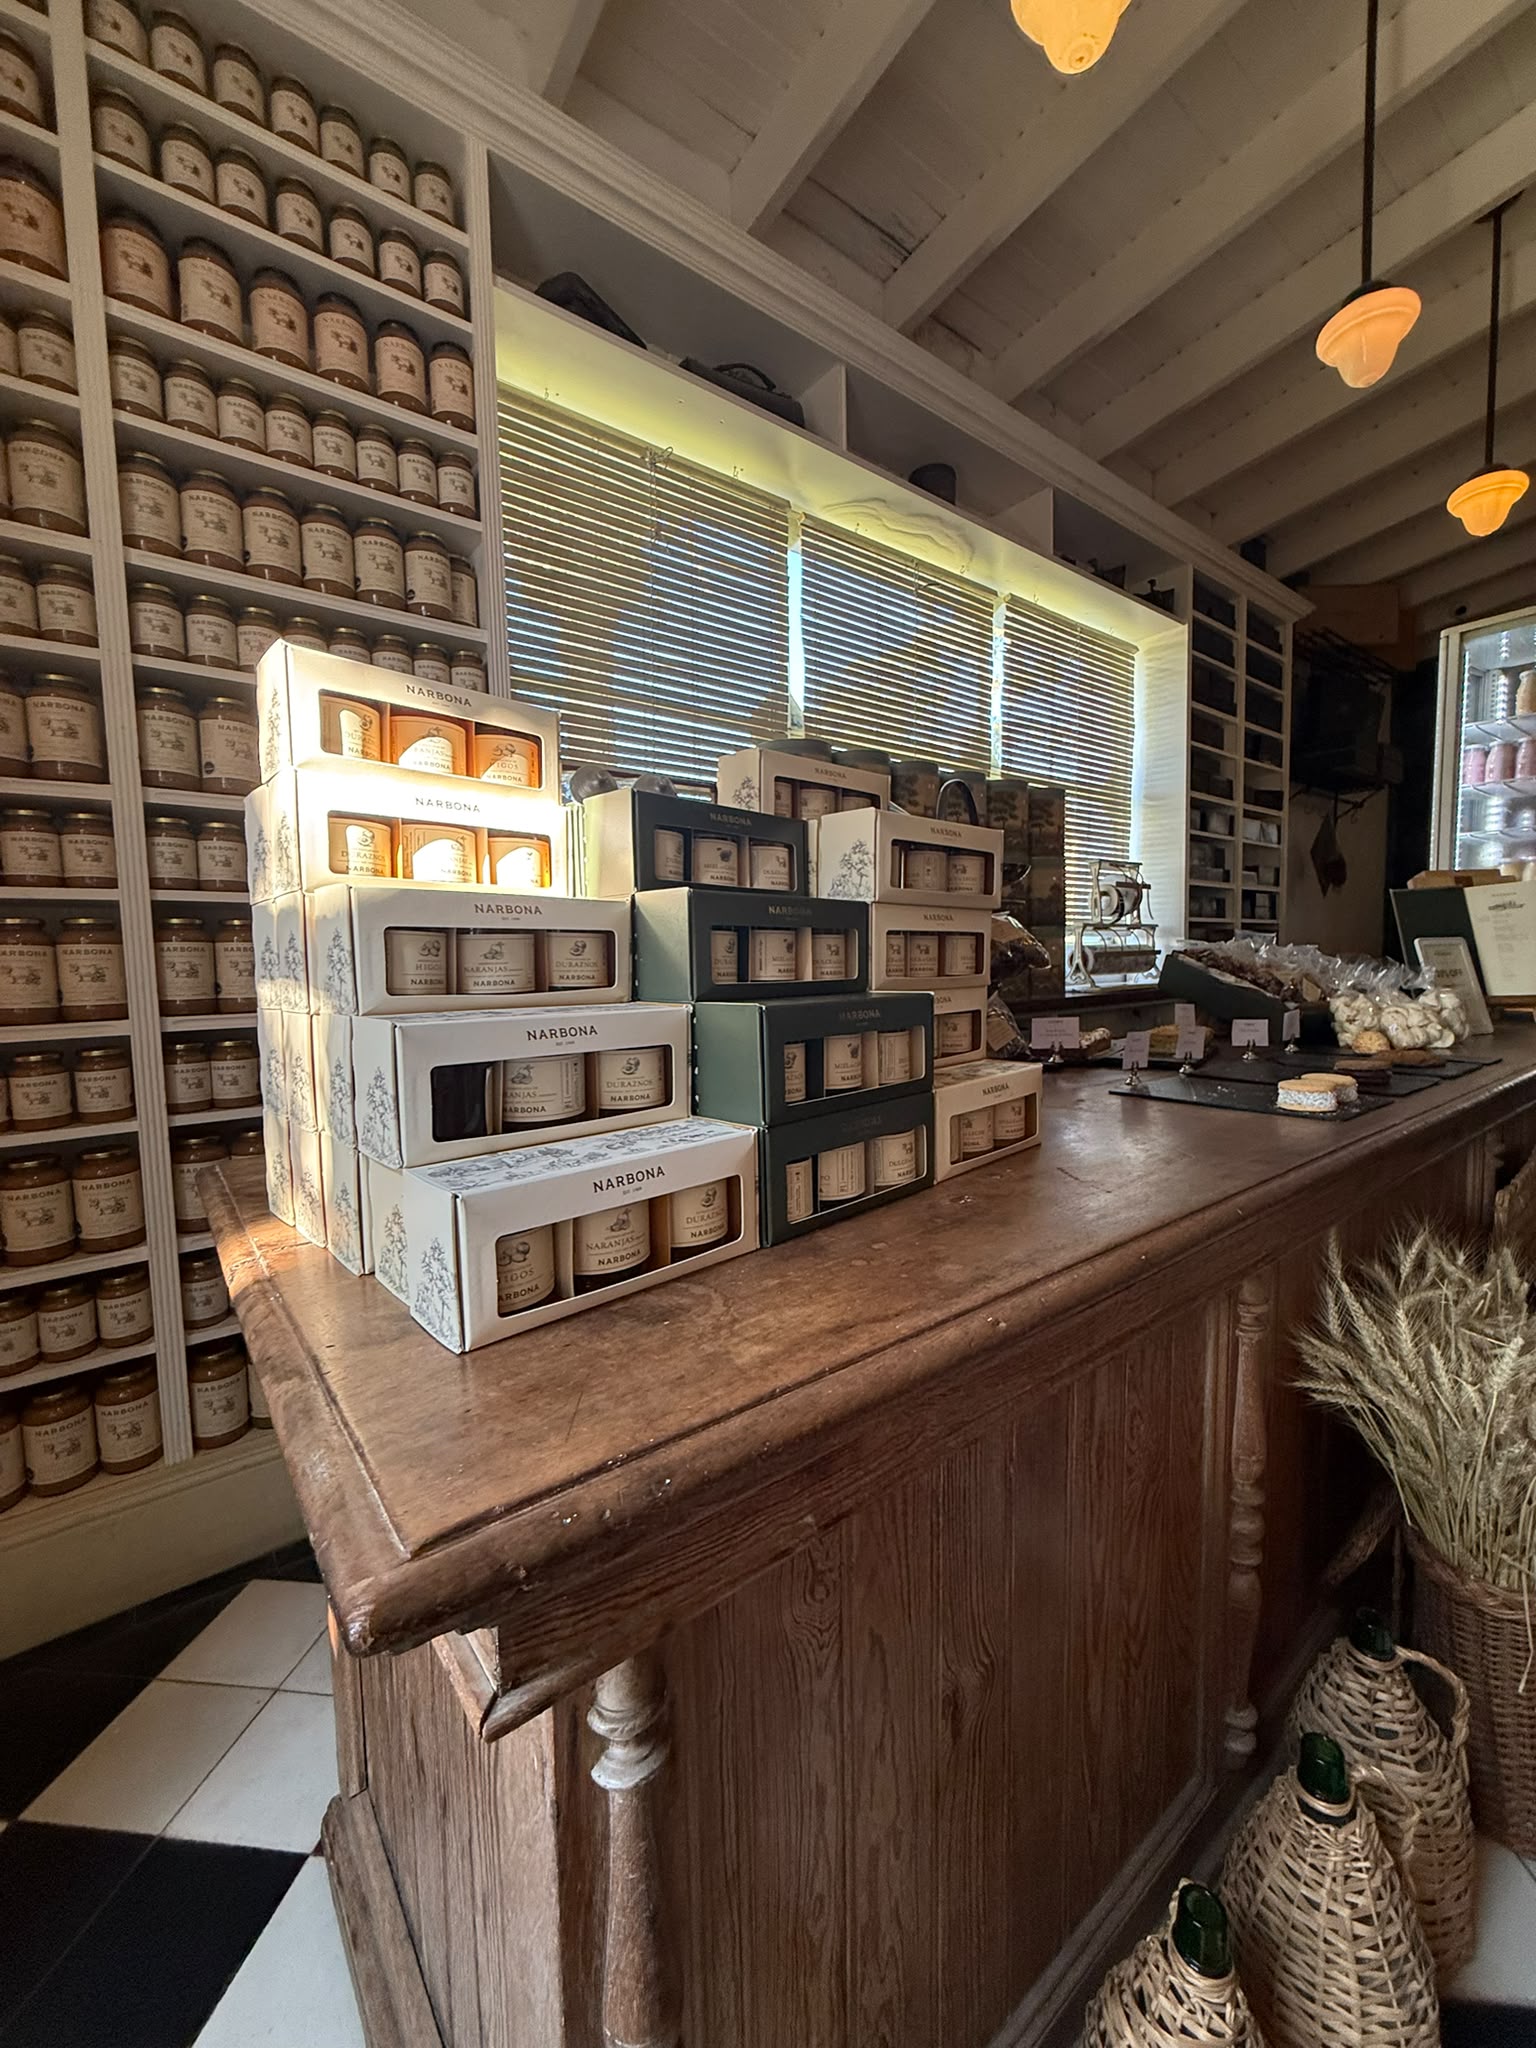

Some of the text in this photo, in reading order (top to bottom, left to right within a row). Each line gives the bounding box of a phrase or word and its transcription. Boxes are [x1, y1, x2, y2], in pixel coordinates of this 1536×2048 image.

[251, 510, 296, 528] NARBONA
[307, 526, 349, 542] NARBONA
[405, 684, 473, 708] NARBONA
[31, 701, 87, 714] NARBONA
[143, 713, 192, 728] NARBONA
[217, 723, 258, 735] NARBO
[415, 796, 481, 813] NARBONA
[340, 851, 386, 861] DRAZNOS
[474, 903, 543, 915] NARBONA
[0, 949, 48, 958] ARBONA
[61, 948, 114, 957] NARBONA
[160, 946, 206, 955] NARBONA
[223, 946, 255, 955] NARBO
[473, 979, 516, 988] NARBONA
[558, 974, 597, 982] NARBONA
[526, 1024, 599, 1042] NARBONA
[503, 1090, 538, 1100] RANJAS
[610, 1092, 651, 1103] NARBONA
[80, 1177, 133, 1192] NARBONA
[592, 1165, 666, 1194] NARBONA
[5, 1187, 63, 1202] NARBONA
[585, 1234, 635, 1252] NARANJAS
[597, 1248, 642, 1267] NARBONA
[502, 1267, 535, 1284] IGOS
[498, 1282, 540, 1302] ARBONA
[196, 1376, 242, 1394] NARBONA
[100, 1400, 150, 1418] NARBONA
[34, 1415, 88, 1438] NARBONA
